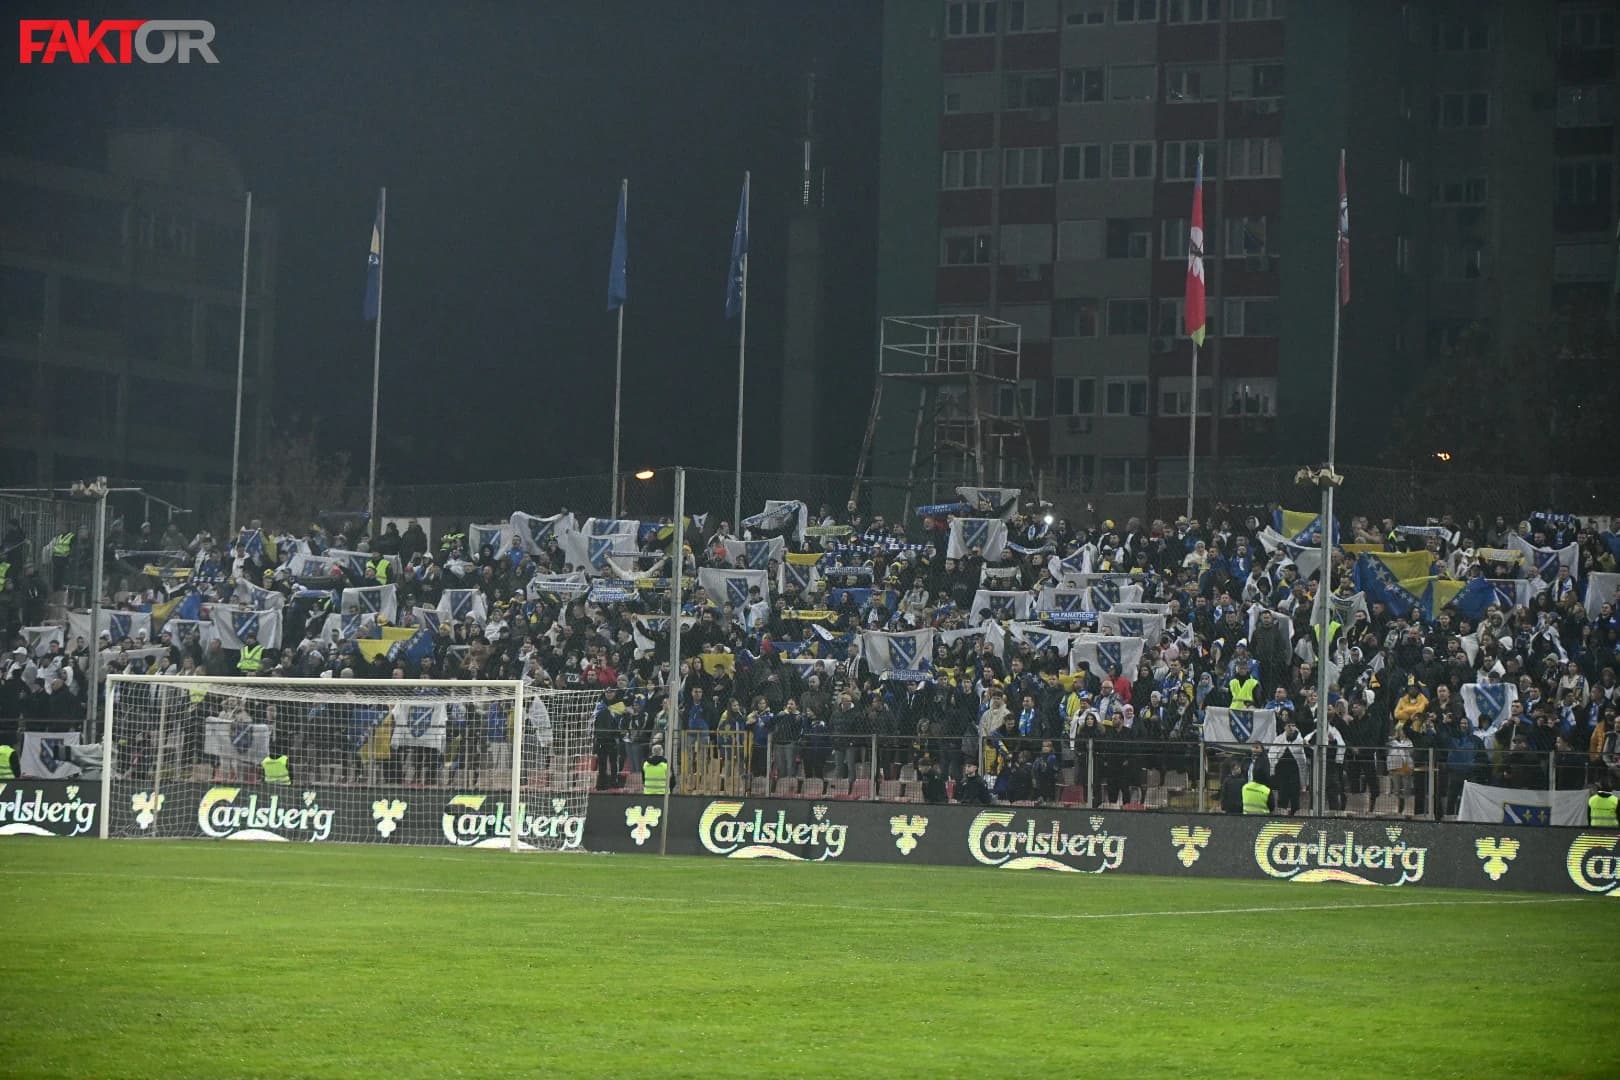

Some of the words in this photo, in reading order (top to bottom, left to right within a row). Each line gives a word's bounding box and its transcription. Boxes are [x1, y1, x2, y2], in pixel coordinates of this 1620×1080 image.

[198, 787, 336, 842] Carlsberg
[442, 794, 586, 851] Carlsberg
[699, 800, 848, 861] Carlsberg
[968, 810, 1128, 873] Carlsberg
[1254, 821, 1428, 886] Carlsberg
